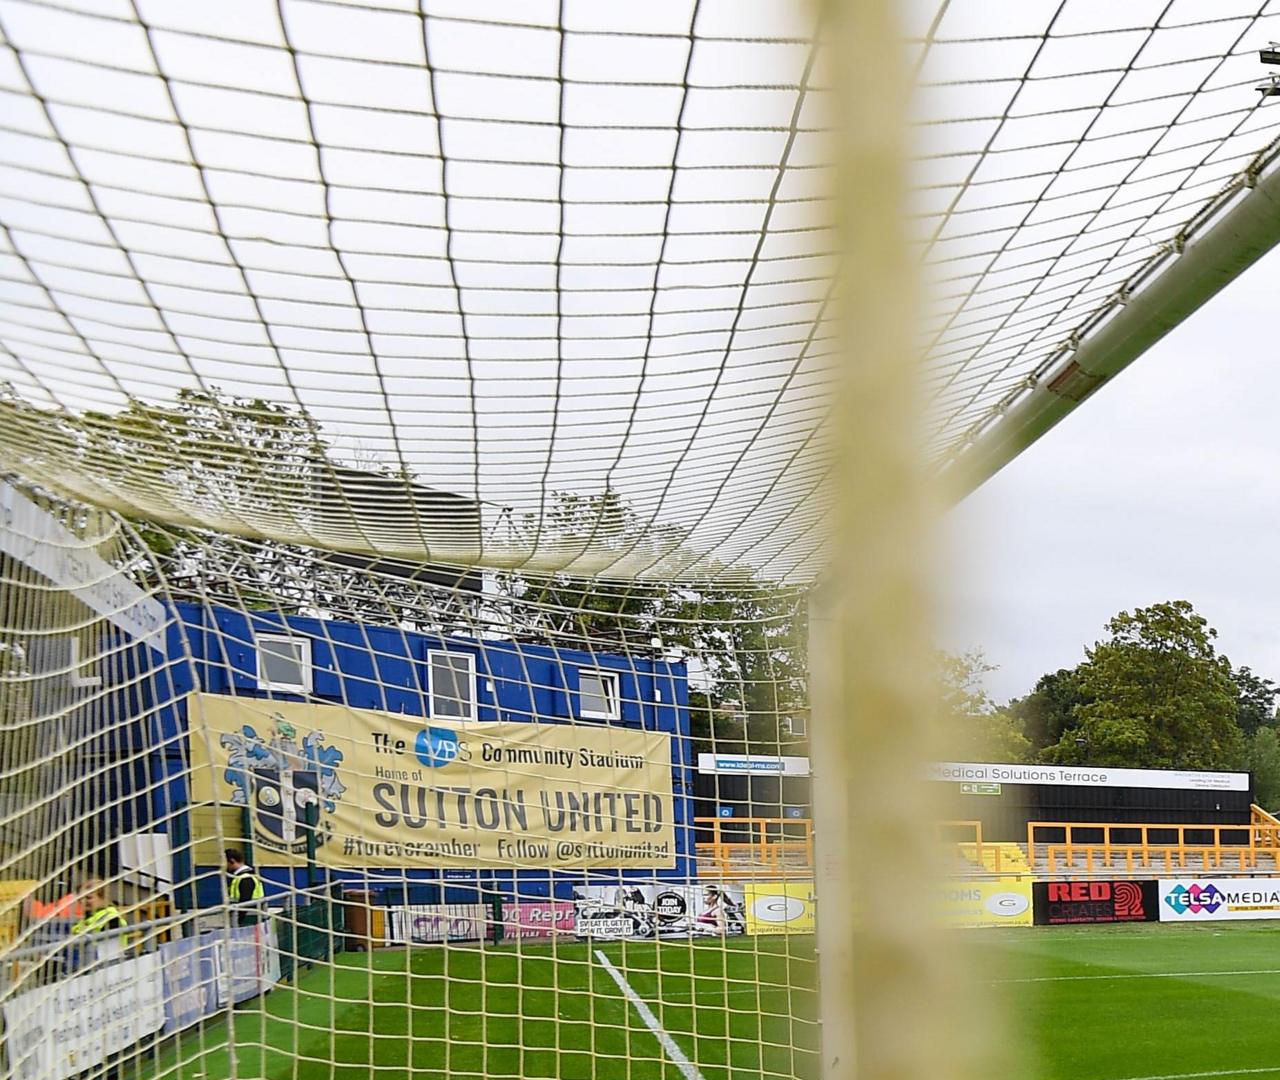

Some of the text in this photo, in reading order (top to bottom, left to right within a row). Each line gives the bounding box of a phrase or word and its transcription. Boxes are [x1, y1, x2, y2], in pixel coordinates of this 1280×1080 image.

[372, 732, 406, 755] The
[482, 743, 574, 768] Community
[580, 748, 643, 769] Stadium
[375, 766, 423, 781] Home of
[992, 768, 1056, 781] Solutions
[1058, 770, 1107, 782] Terrace
[373, 783, 663, 833] SUTTON UNITED
[343, 835, 480, 858] #foreveramber
[498, 839, 549, 858] Follow
[1048, 882, 1111, 901] RED
[1168, 892, 1280, 905] TELSA MEDIA
[658, 898, 682, 914] JOIN TODAY
[1048, 903, 1111, 917] CREATES
[611, 920, 623, 928] GET
